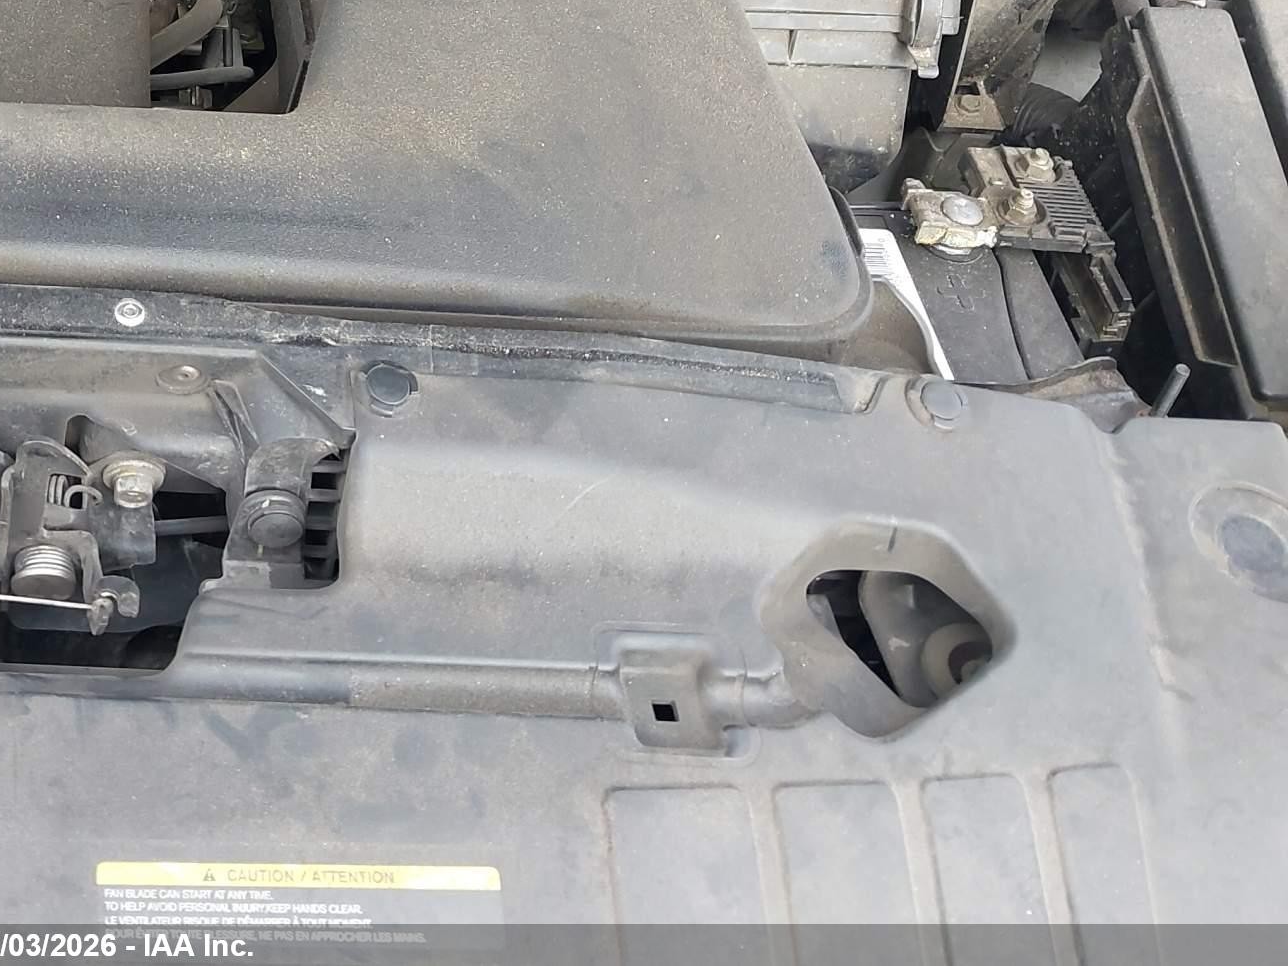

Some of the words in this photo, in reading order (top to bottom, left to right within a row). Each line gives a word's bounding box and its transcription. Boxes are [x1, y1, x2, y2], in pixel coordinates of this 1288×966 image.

[227, 869, 294, 882] CAUTION
[312, 870, 396, 883] ATTENTION
[104, 889, 124, 898] FAN
[125, 889, 158, 899] BLADE
[159, 890, 180, 899] CAN
[182, 890, 213, 899] START
[214, 890, 226, 899] AT
[227, 890, 248, 900] ANY
[104, 902, 119, 911] TO
[120, 902, 145, 912] HELP
[147, 902, 177, 912] AVOID
[179, 903, 232, 913] PERSONAL
[293, 904, 327, 914] HANDS
